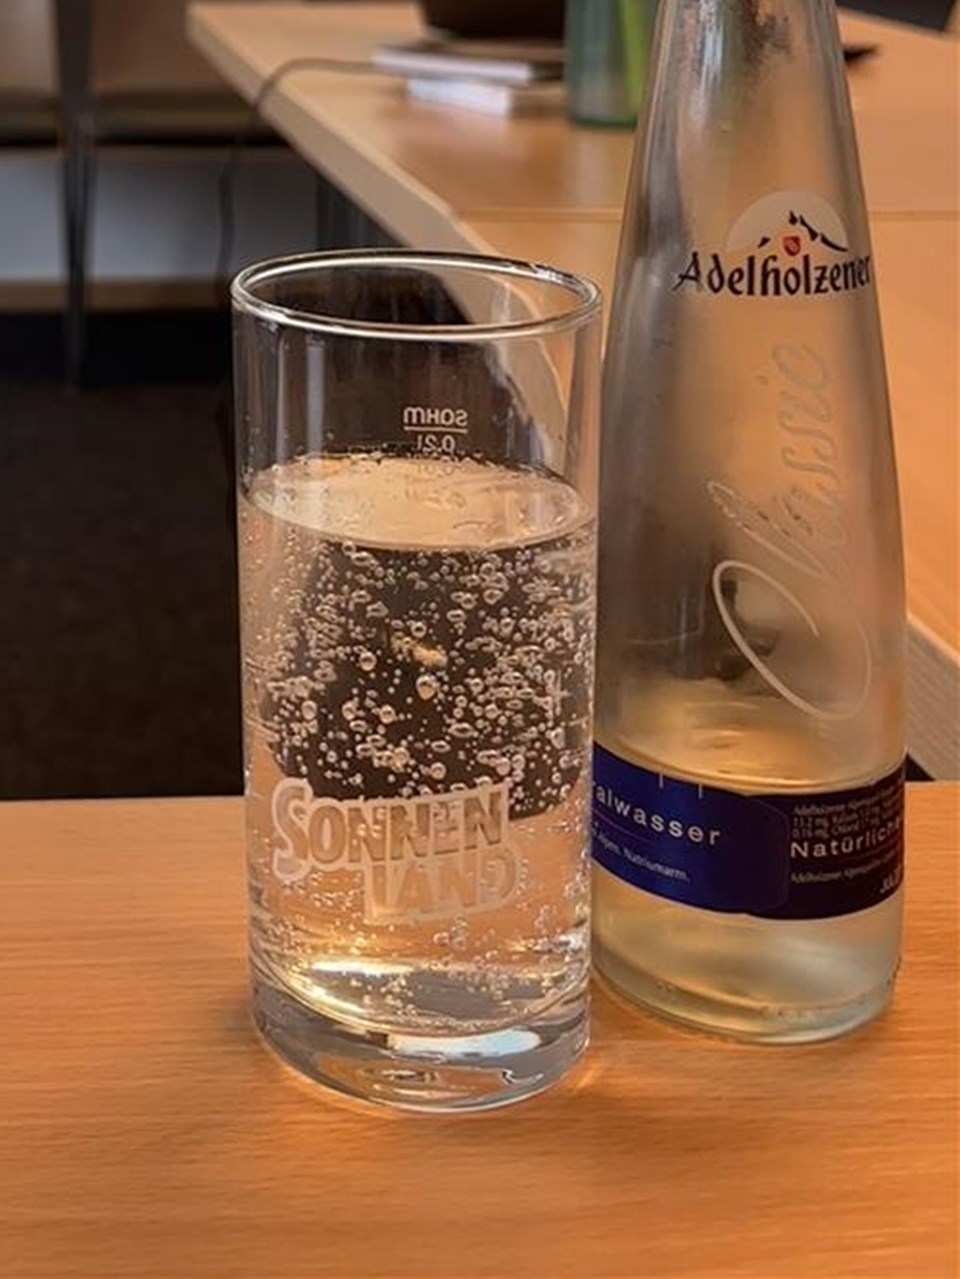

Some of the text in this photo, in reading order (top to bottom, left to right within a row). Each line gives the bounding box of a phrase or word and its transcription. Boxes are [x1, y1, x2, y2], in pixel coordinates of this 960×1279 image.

[672, 251, 871, 296] Adelholzener
[271, 777, 510, 882] SONNEN
[591, 780, 721, 846] alwasser
